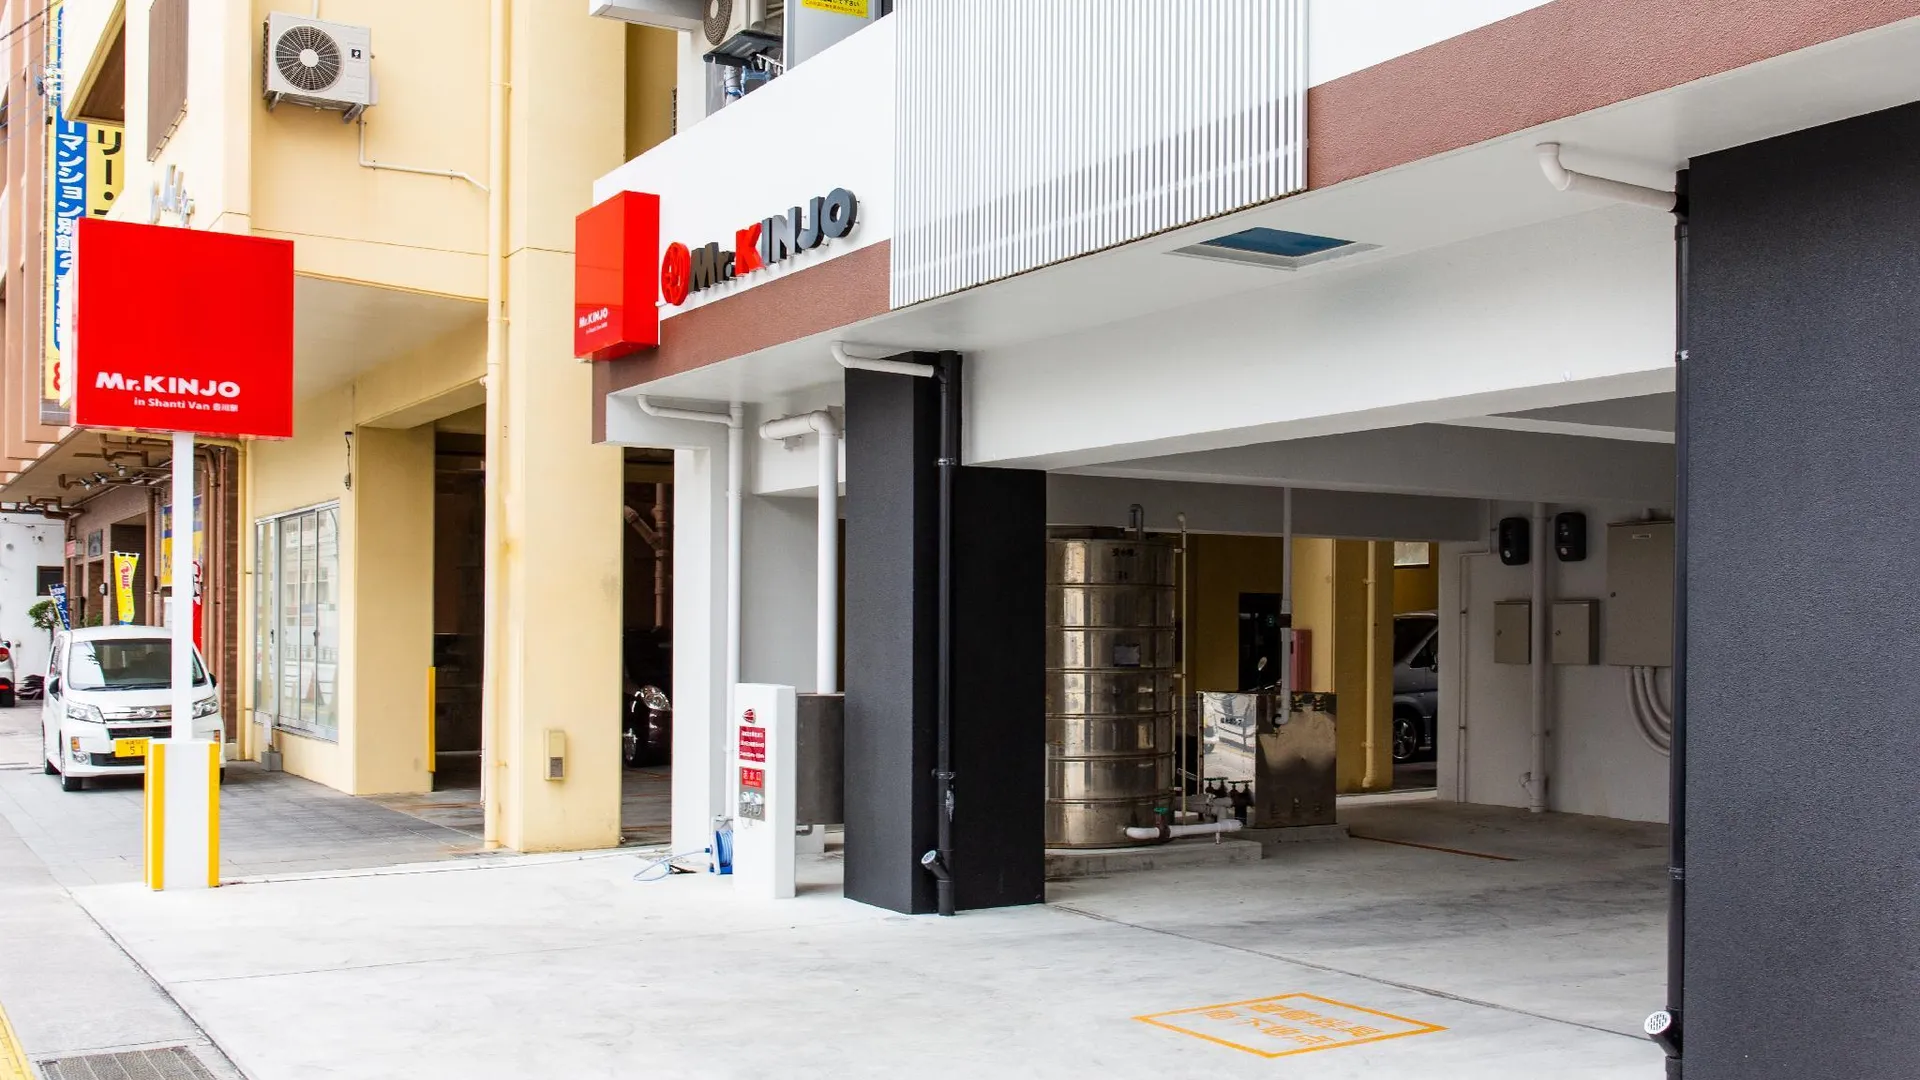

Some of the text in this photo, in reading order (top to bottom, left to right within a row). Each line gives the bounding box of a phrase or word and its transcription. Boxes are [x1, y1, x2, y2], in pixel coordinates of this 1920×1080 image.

[689, 187, 857, 292] Mr.KINJO
[95, 371, 241, 397] Mr.KINJO
[134, 397, 146, 406] in
[148, 398, 186, 409] Shanti
[189, 401, 210, 411] Van
